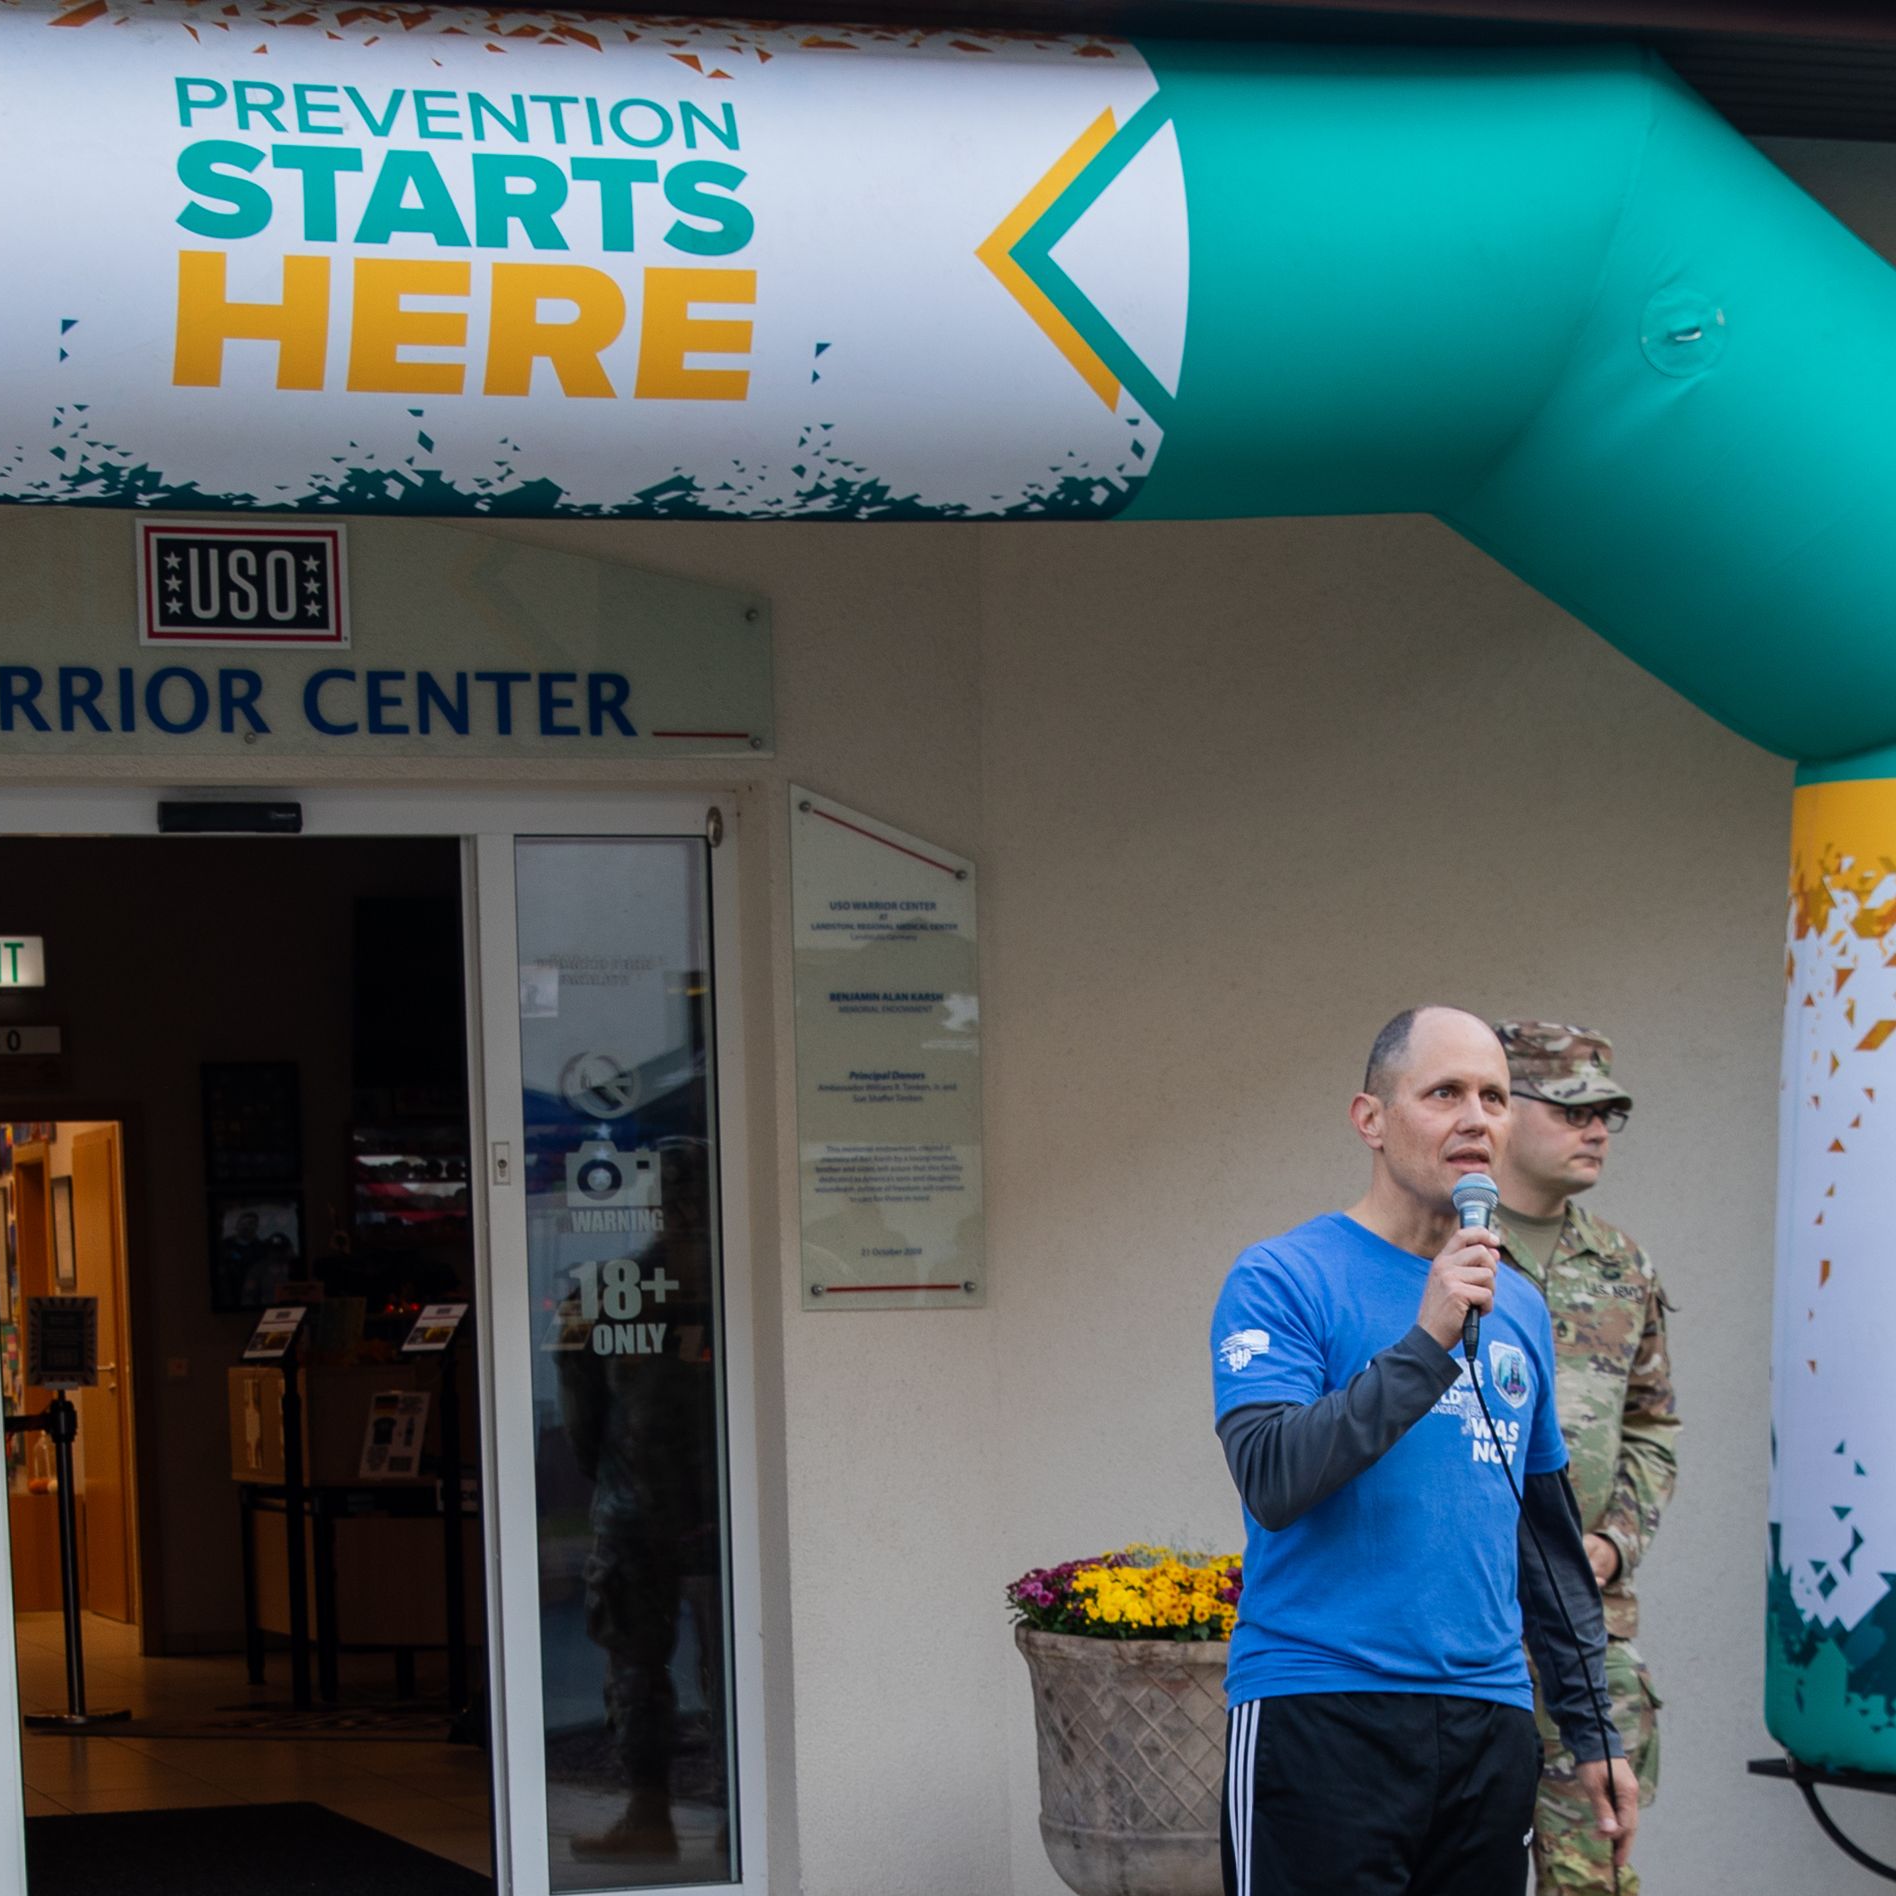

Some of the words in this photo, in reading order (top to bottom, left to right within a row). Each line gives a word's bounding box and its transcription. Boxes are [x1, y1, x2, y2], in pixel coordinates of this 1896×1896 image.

[172, 76, 742, 152] PREVENTION
[174, 139, 757, 258] STARTS
[172, 249, 758, 402] HERE
[189, 547, 300, 621] USO
[301, 666, 638, 739] CENTER
[829, 901, 851, 911] USO
[853, 901, 898, 911] WARRIOR
[899, 901, 937, 911] CENTER
[857, 923, 894, 931] REGIONAL
[828, 992, 879, 1002] BENJAMIN
[881, 992, 909, 1001] ALAN
[911, 992, 944, 1002] KARSH
[838, 1005, 880, 1013] MEMORIAL
[882, 1005, 933, 1013] ENDOWMENT
[817, 1083, 864, 1092] Ambassador
[849, 1071, 890, 1081] Principal
[892, 1072, 926, 1080] Donors
[571, 1208, 664, 1233] WARNING
[872, 1247, 903, 1257] October
[567, 1258, 679, 1322] 18+
[591, 1322, 667, 1356] ONLY
[1471, 1417, 1519, 1442] WAS
